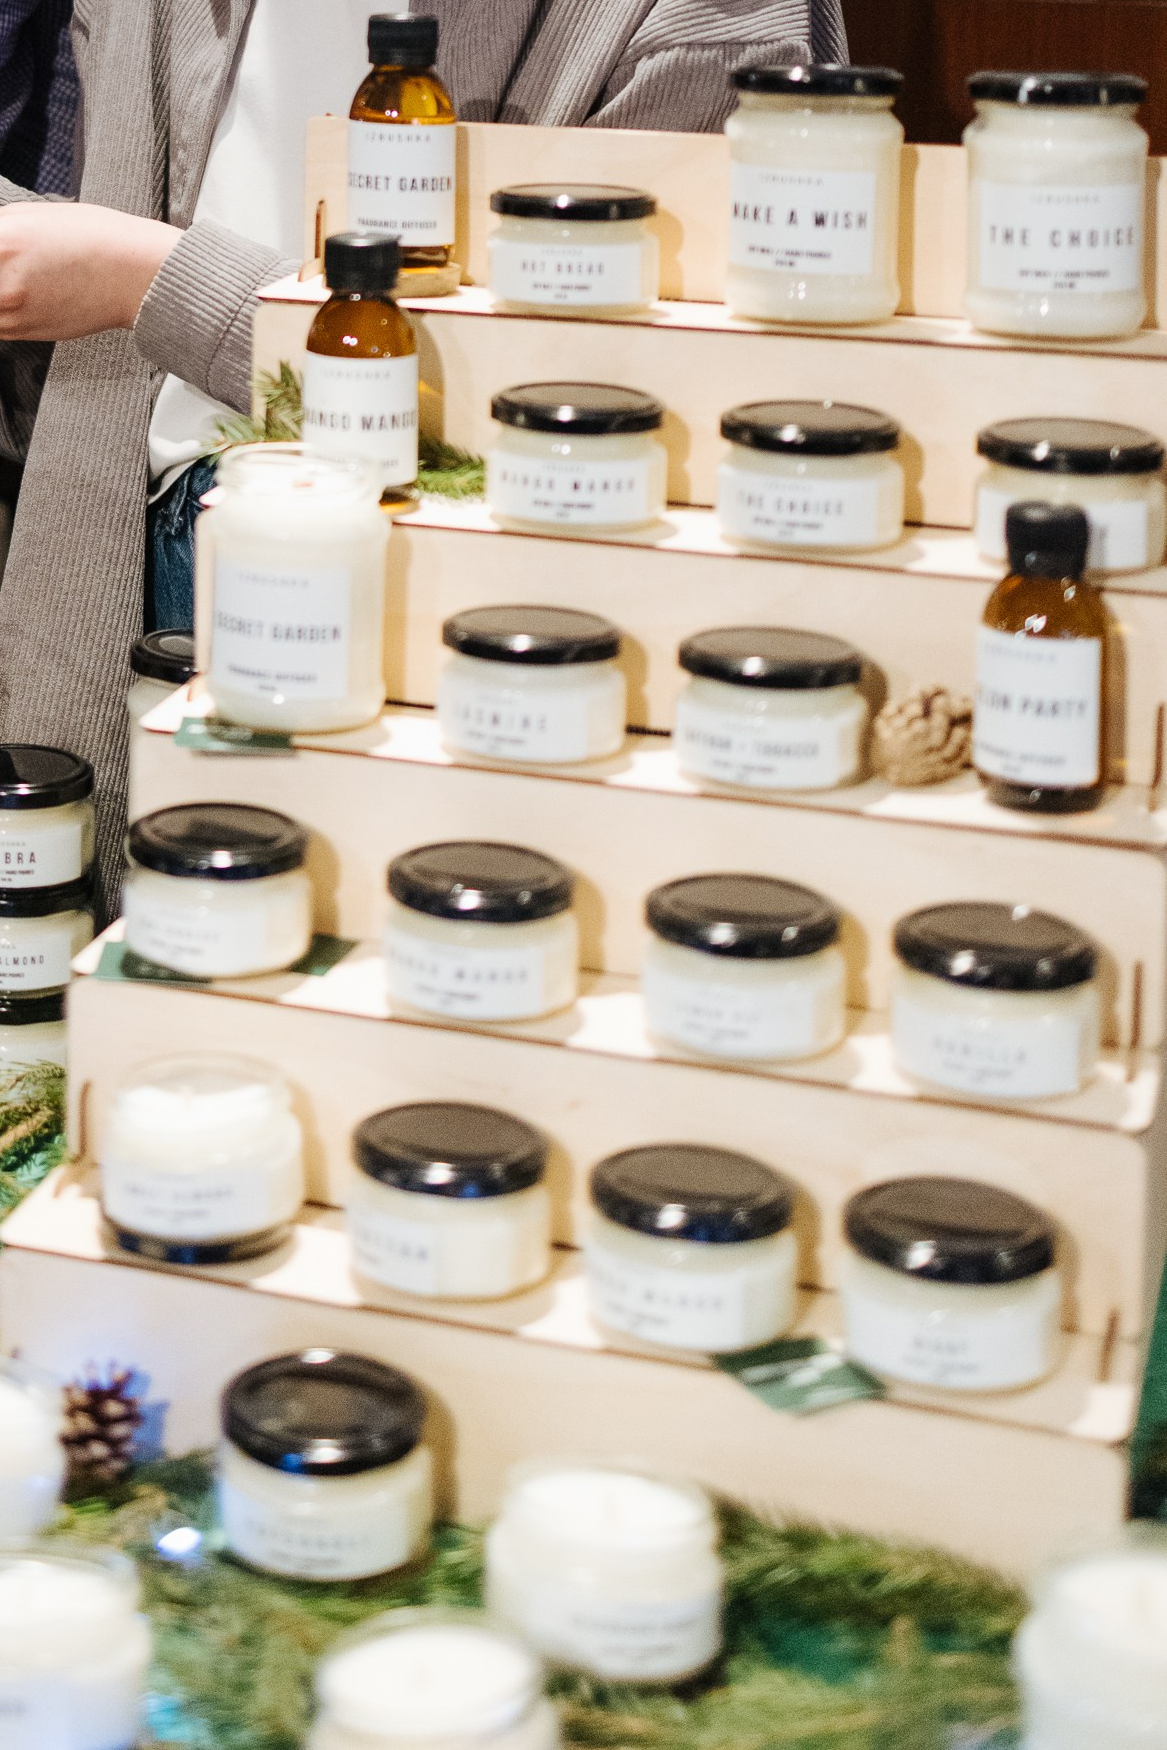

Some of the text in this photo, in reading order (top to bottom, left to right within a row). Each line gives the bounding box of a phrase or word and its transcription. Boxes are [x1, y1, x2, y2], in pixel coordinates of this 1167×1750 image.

[349, 172, 452, 192] SECRET GARDEN
[788, 208, 798, 226] A
[814, 210, 868, 229] WISH
[990, 224, 1134, 248] THE CHOICE
[360, 411, 416, 431] MANGO
